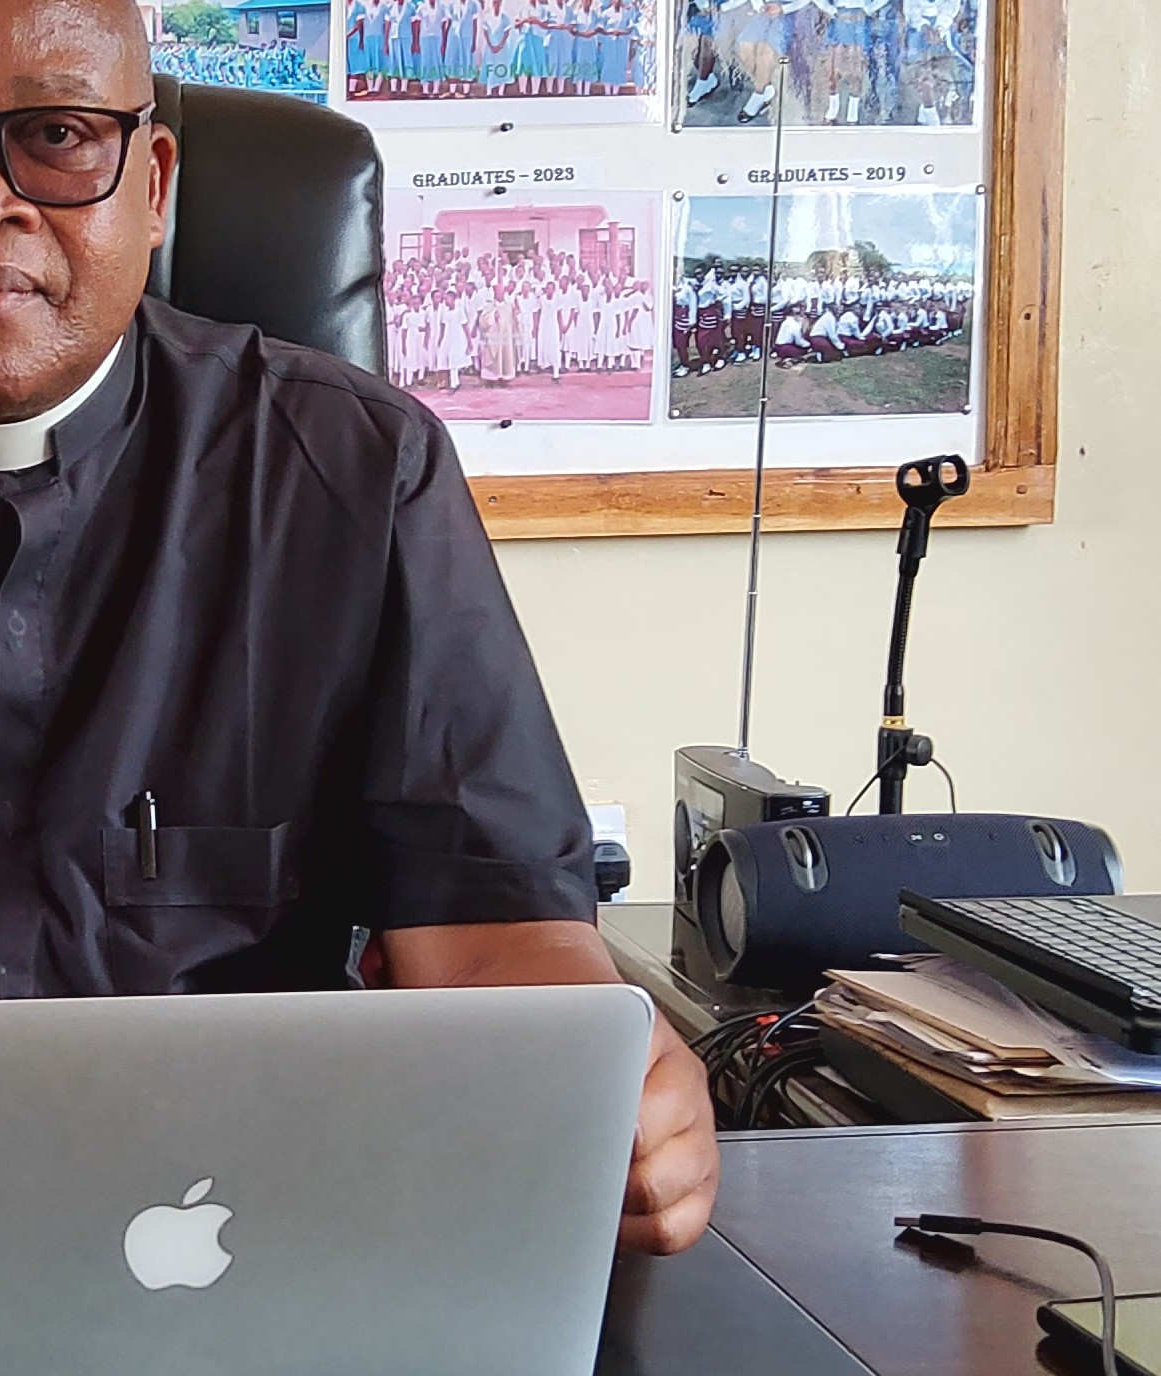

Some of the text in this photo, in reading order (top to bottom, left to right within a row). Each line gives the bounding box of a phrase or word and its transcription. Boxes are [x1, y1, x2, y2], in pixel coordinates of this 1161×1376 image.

[412, 168, 574, 187] GRADUATES 2023
[748, 167, 906, 183] GRADUATES 2019
